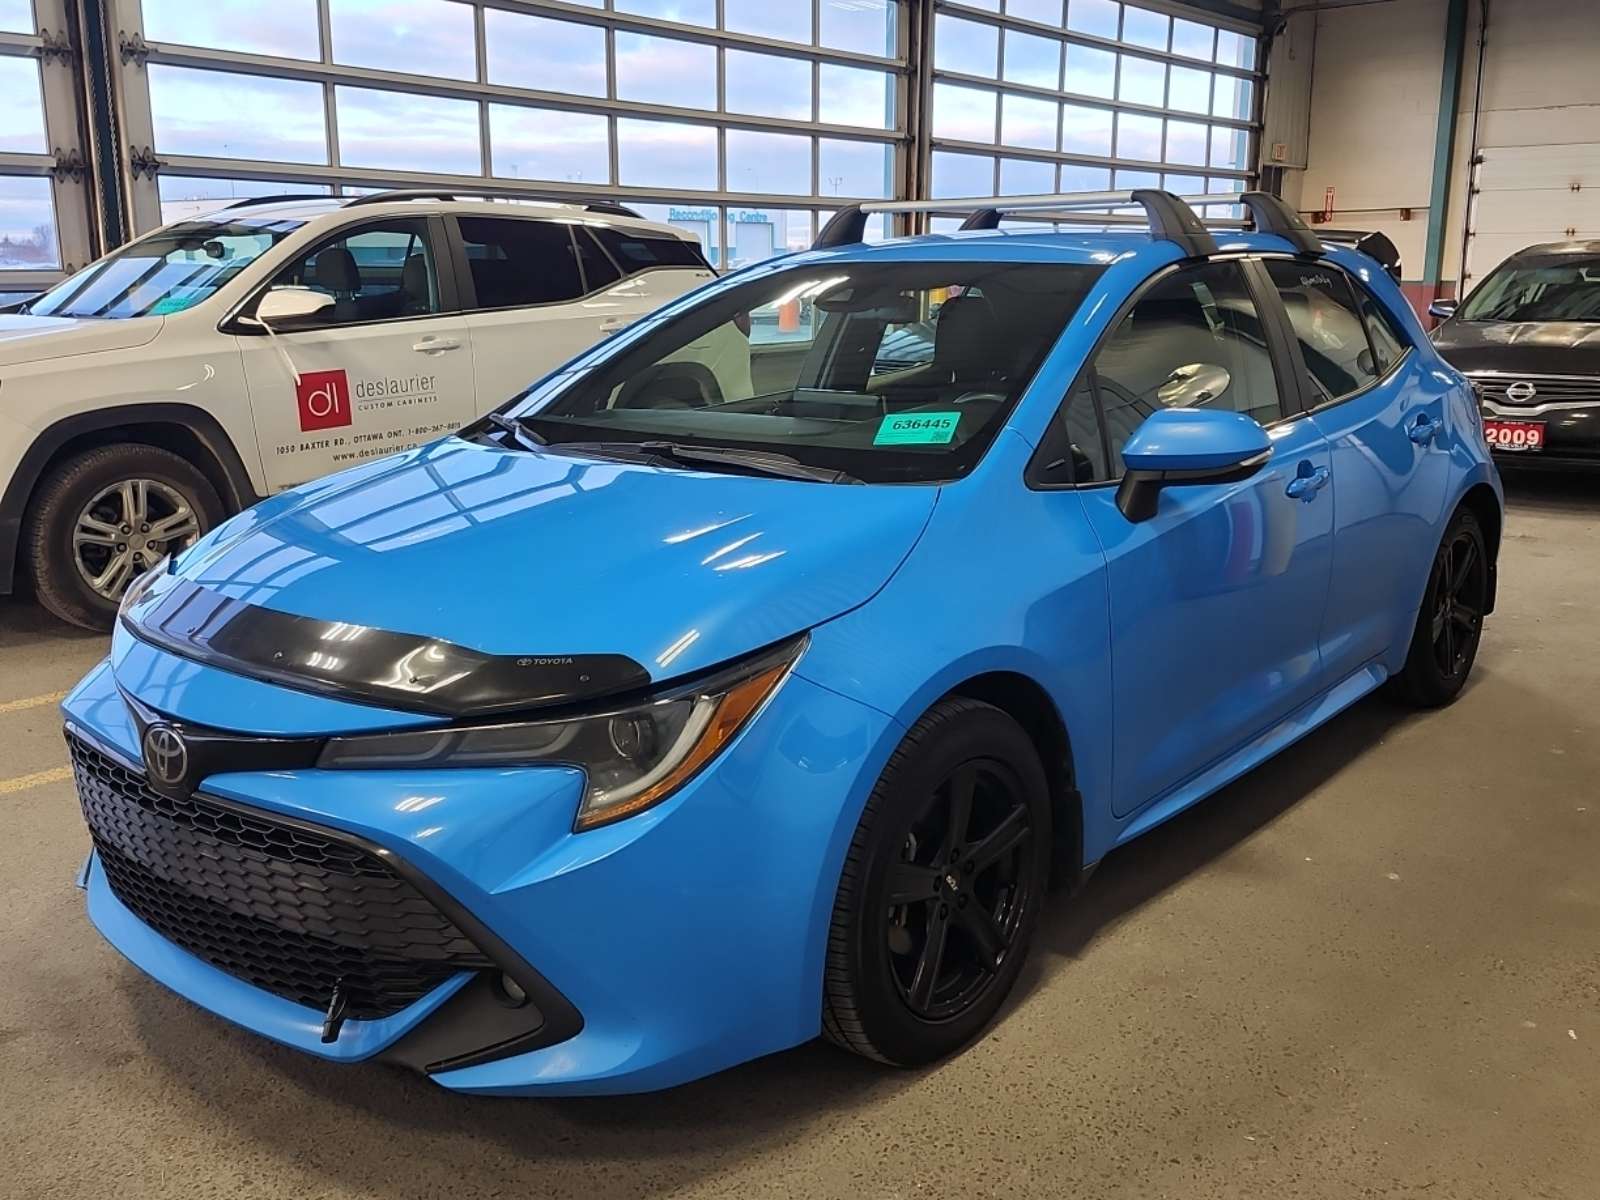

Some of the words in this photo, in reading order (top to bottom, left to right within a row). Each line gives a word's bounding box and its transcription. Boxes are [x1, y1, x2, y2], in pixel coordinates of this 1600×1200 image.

[740, 211, 768, 222] Centre
[356, 374, 436, 398] deslaurier
[308, 382, 340, 416] dl
[358, 400, 393, 411] CUSTOM
[397, 396, 438, 406] CABINETS
[892, 418, 951, 430] 636445
[276, 445, 295, 455] 1050
[300, 440, 330, 452] BAXTER
[353, 432, 384, 444] OTTAWA
[1485, 428, 1540, 445] 2009
[534, 657, 574, 665] TOYOTA
